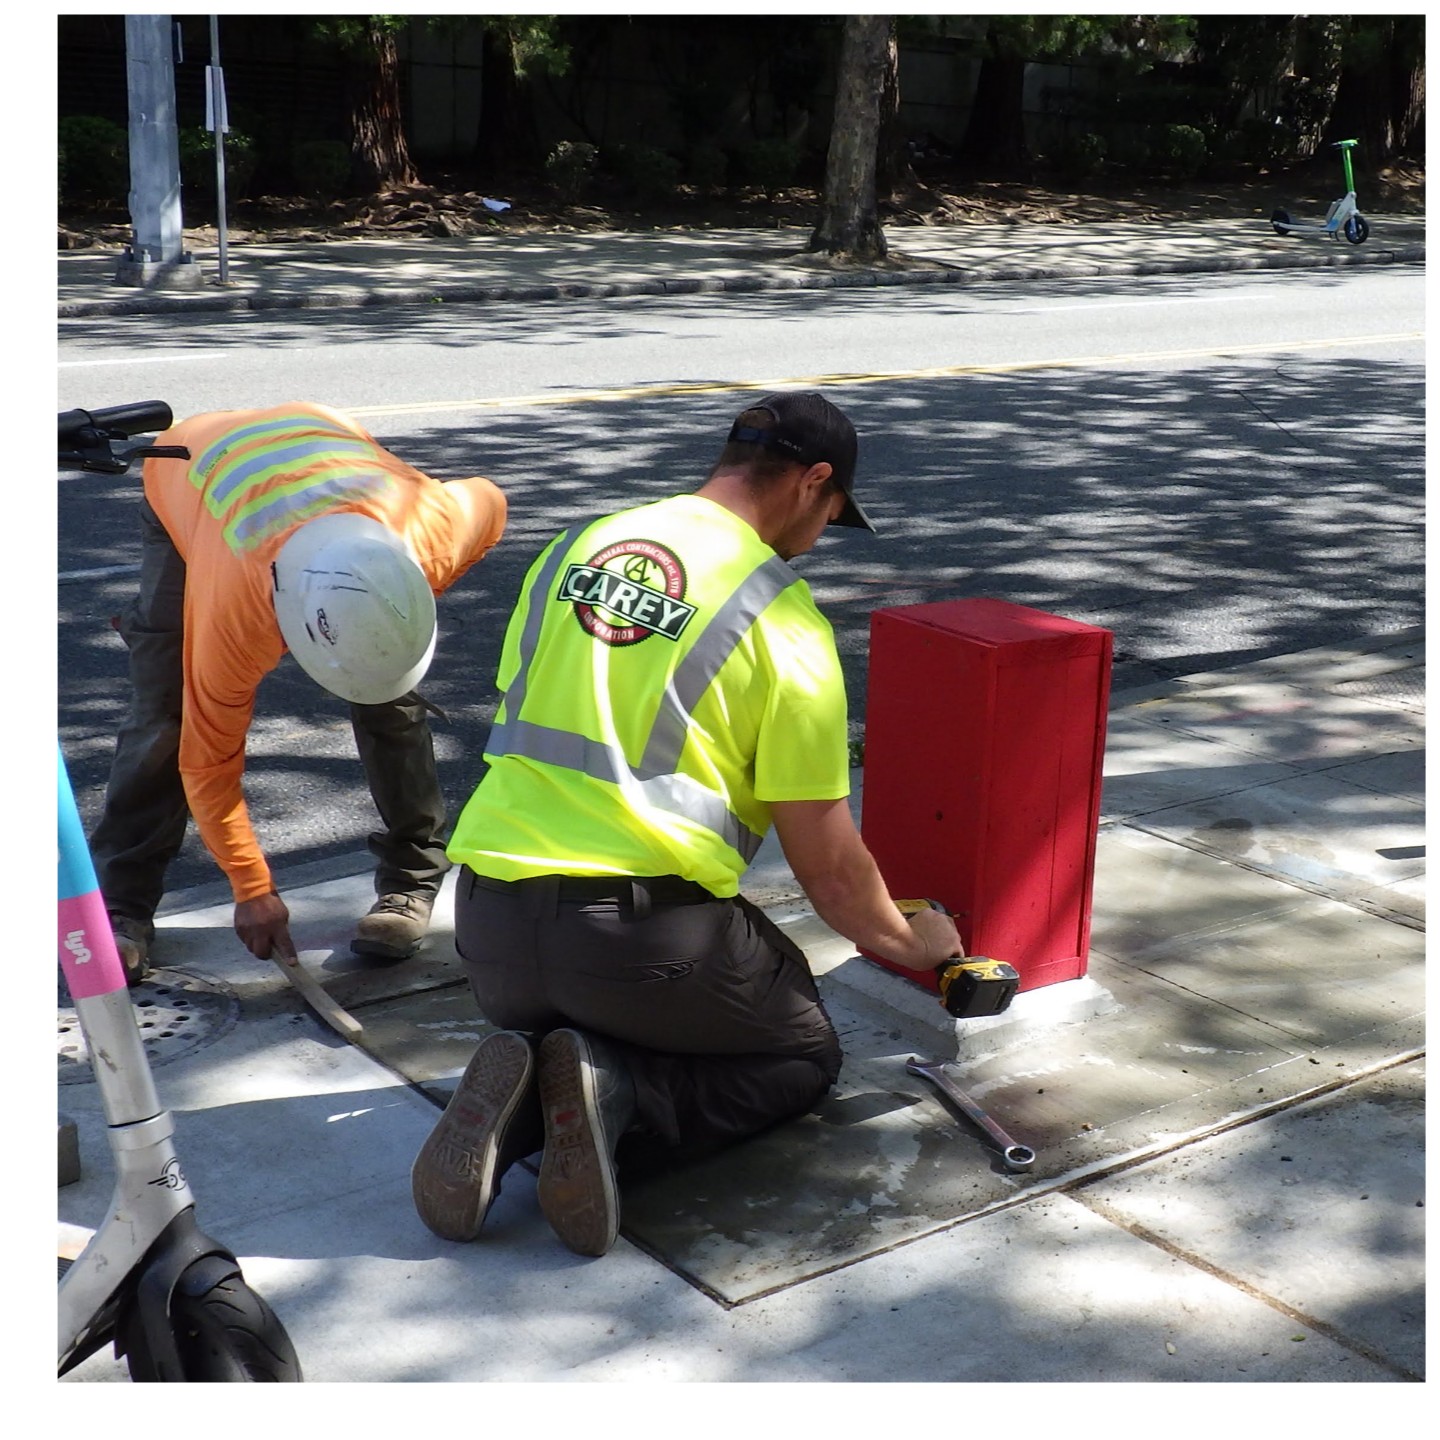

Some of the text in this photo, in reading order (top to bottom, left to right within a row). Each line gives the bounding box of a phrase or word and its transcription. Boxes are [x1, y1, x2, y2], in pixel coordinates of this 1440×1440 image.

[594, 544, 625, 565] GENERAL
[626, 543, 670, 566] CONTRACTORS
[567, 569, 689, 630] CAREY
[584, 611, 635, 639] CORPORATION
[64, 930, 91, 964] lyft
